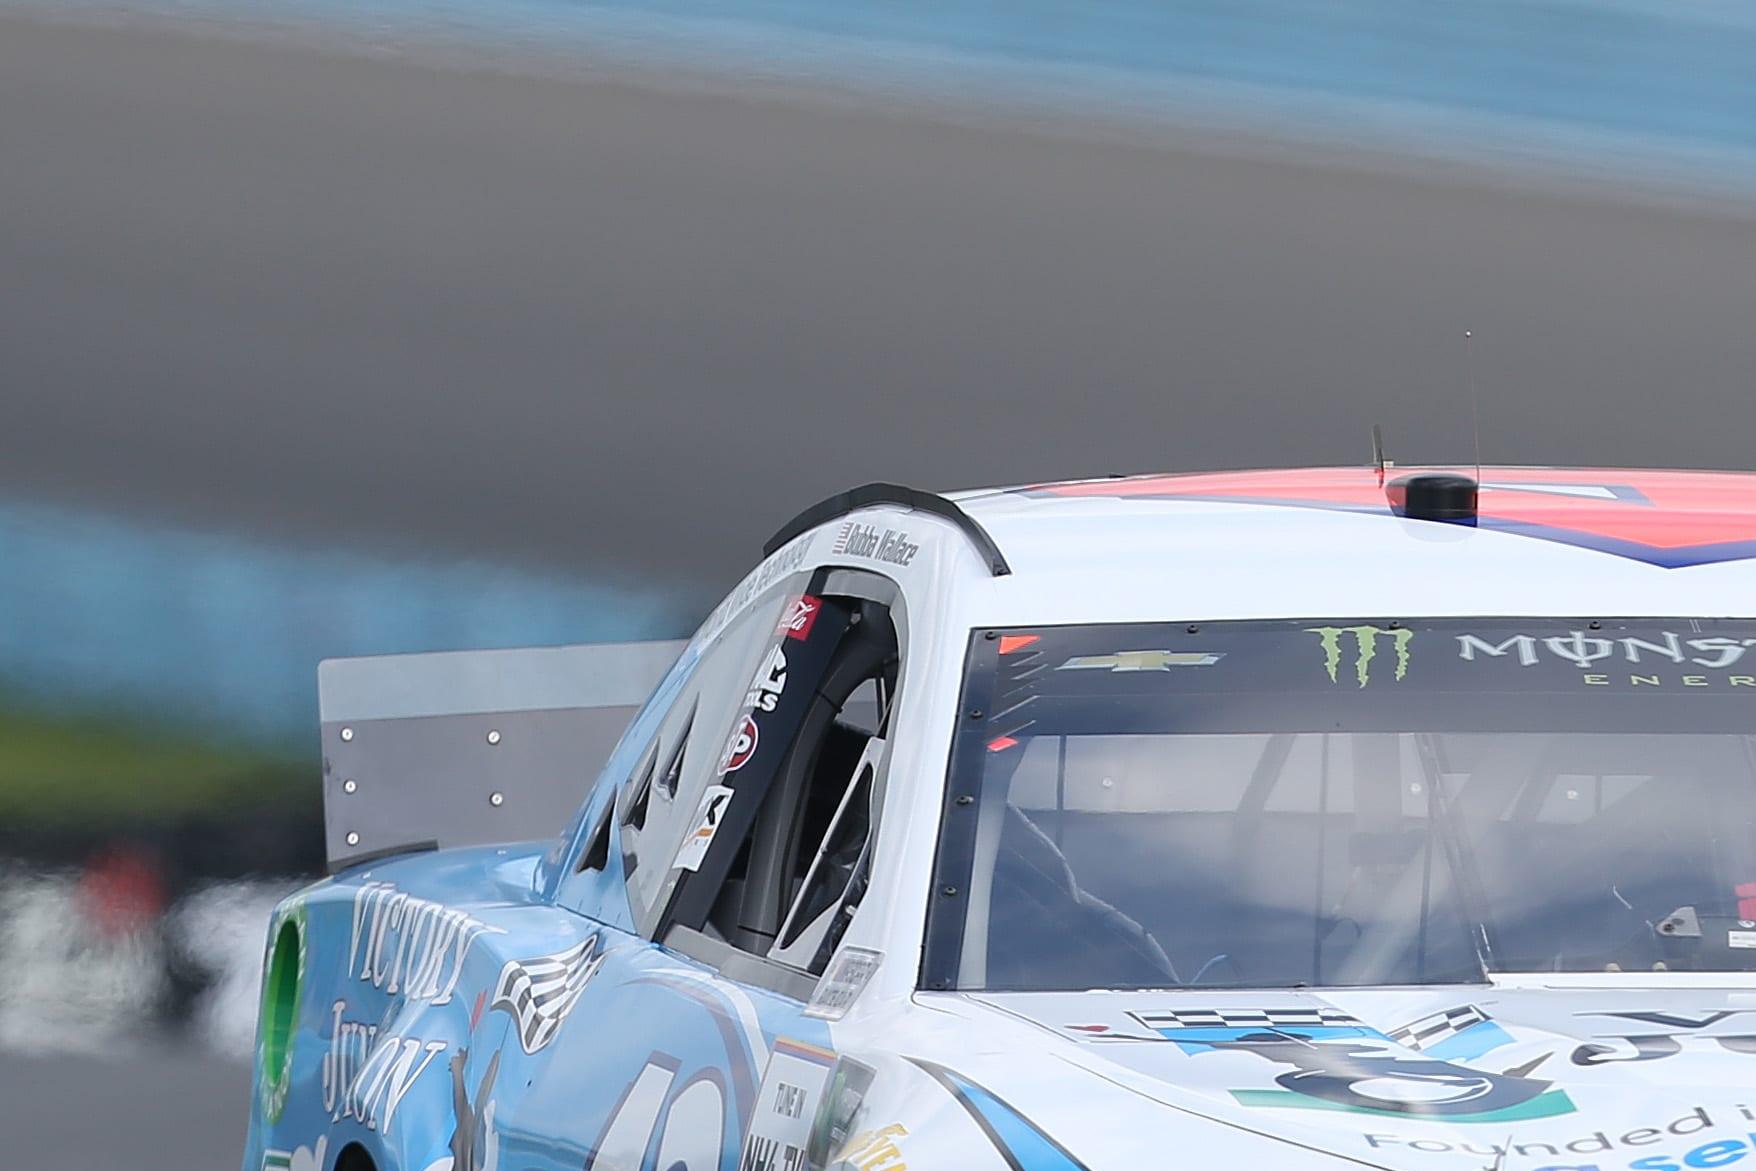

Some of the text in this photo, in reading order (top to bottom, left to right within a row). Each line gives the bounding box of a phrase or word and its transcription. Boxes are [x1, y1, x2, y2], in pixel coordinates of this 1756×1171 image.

[875, 529, 920, 567] Wallace
[350, 880, 508, 1005] VICTORY
[1363, 1107, 1714, 1156] Founded
